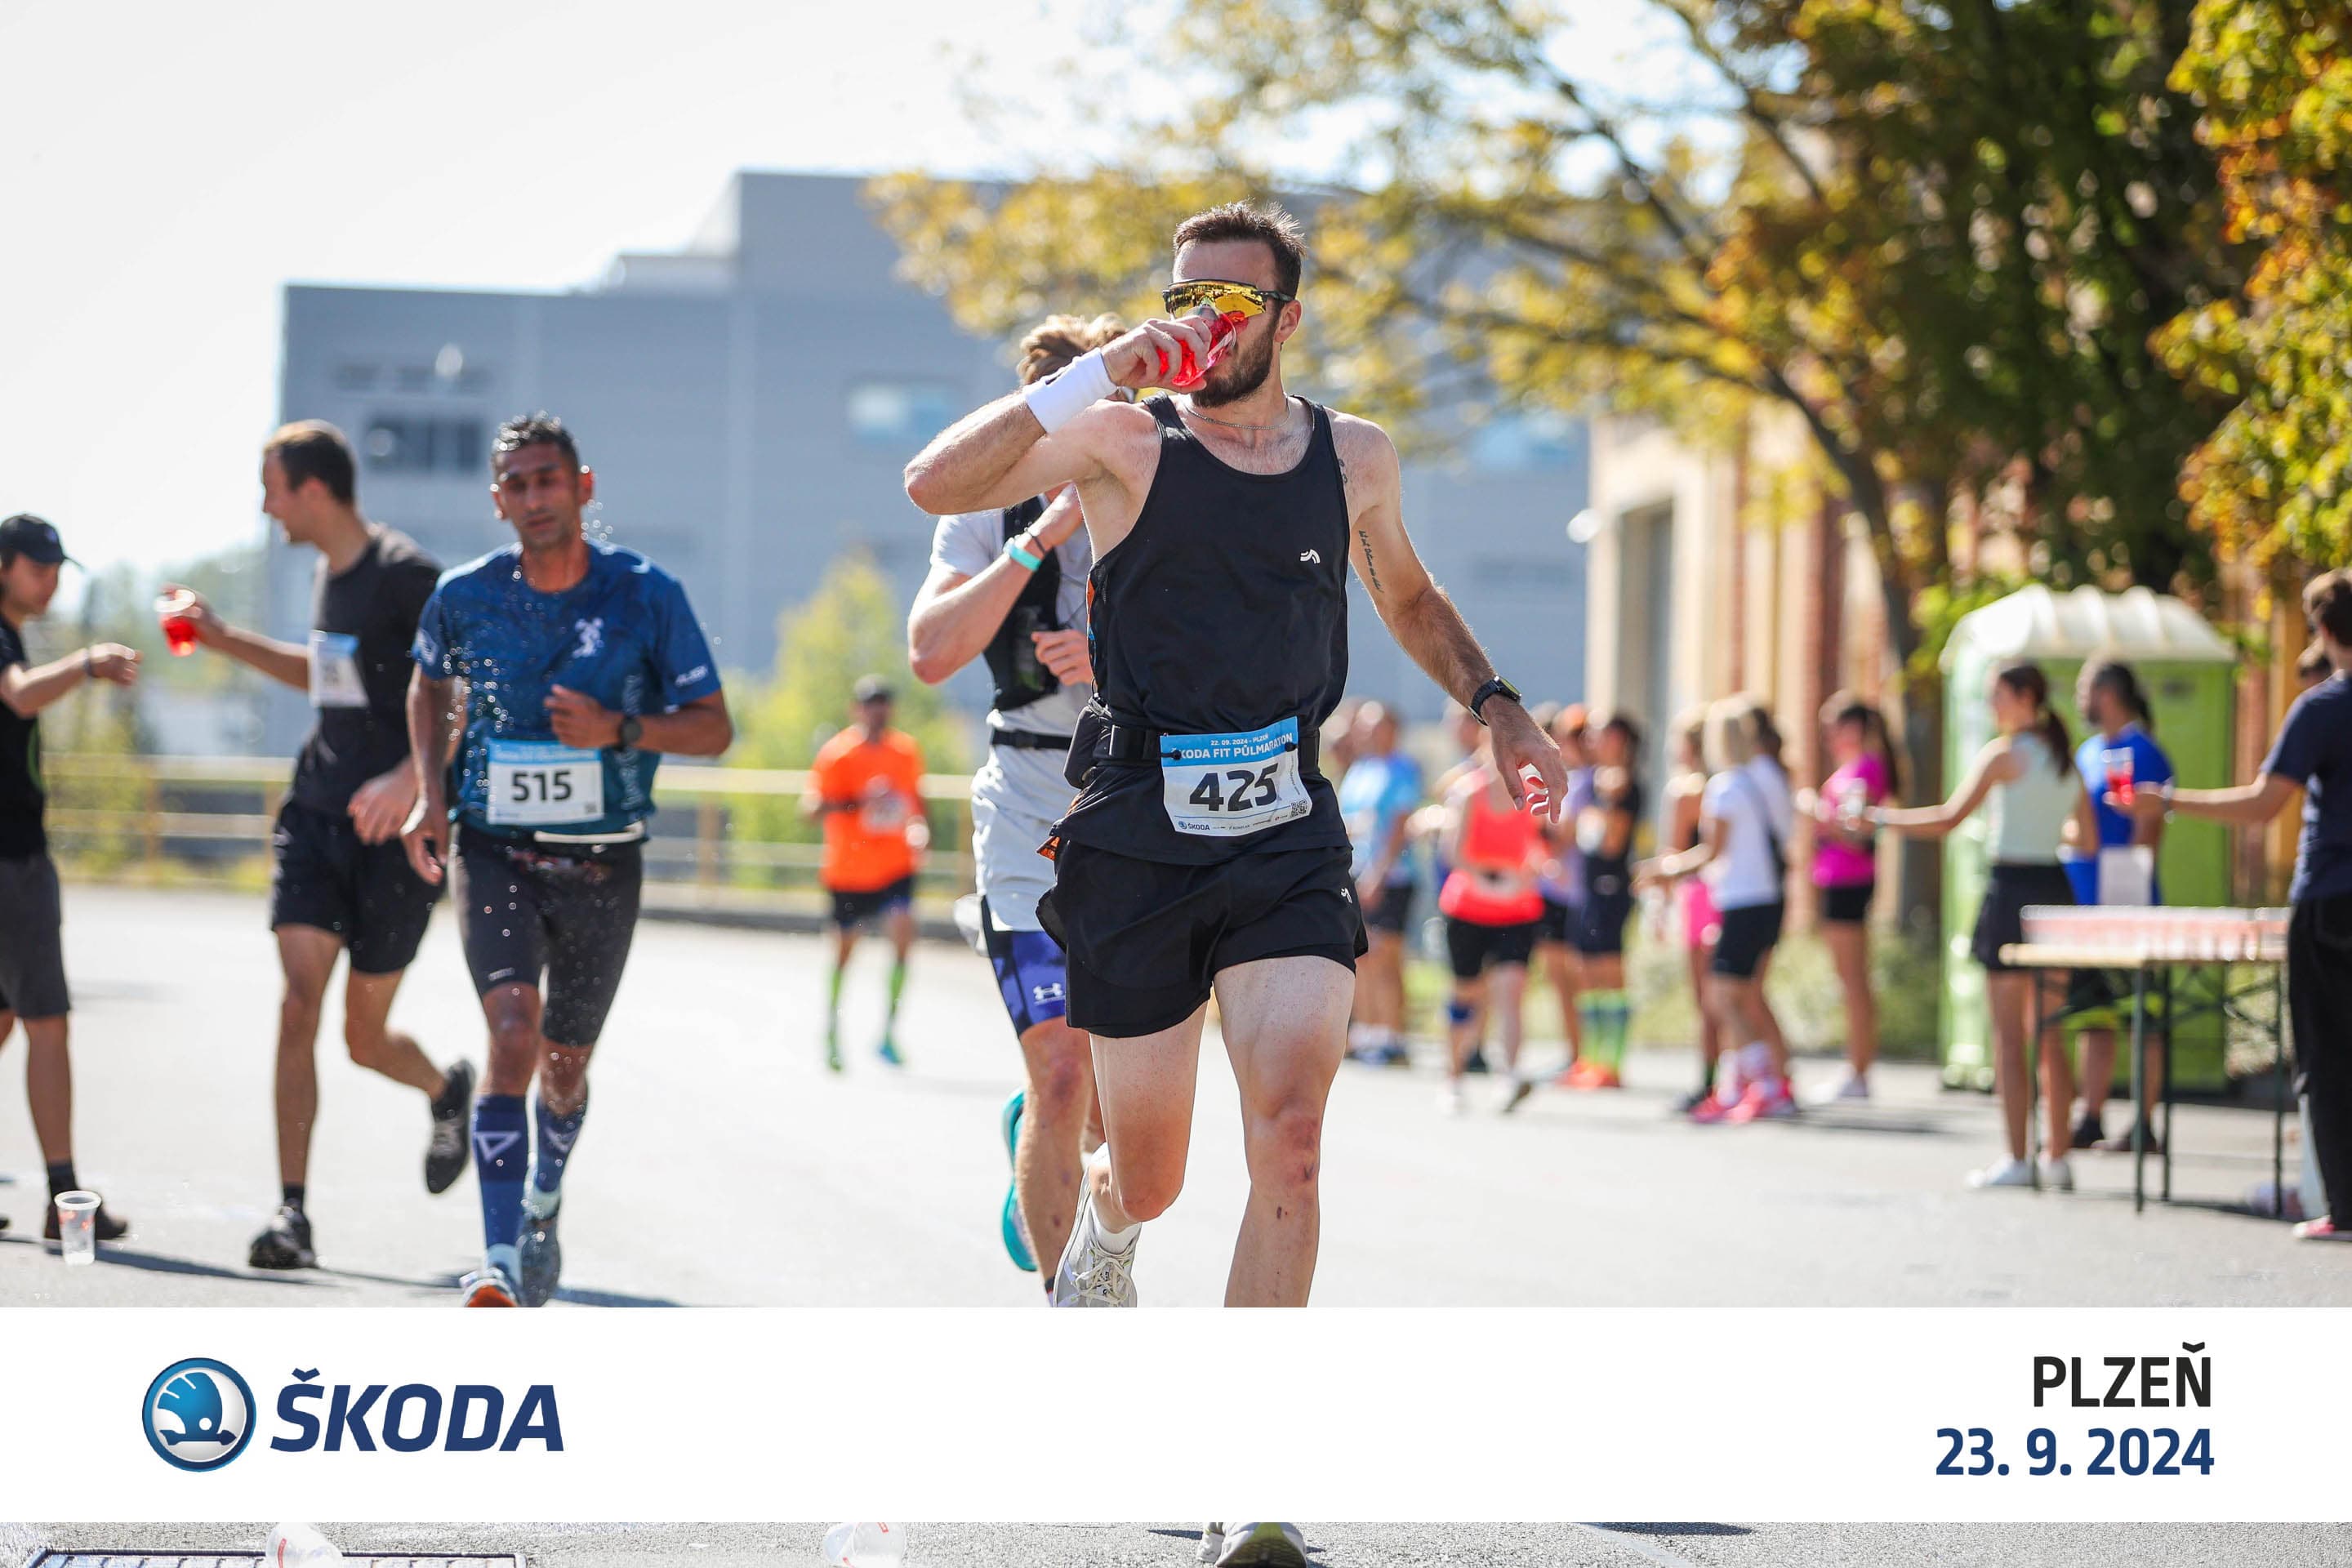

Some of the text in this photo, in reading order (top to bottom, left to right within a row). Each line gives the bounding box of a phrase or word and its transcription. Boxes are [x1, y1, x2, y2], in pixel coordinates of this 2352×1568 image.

[1170, 733, 1293, 759] KODA FIT PŮLMARATON
[513, 772, 571, 801] 515
[1189, 763, 1279, 812] 425
[1187, 822, 1210, 831] ŠKODA
